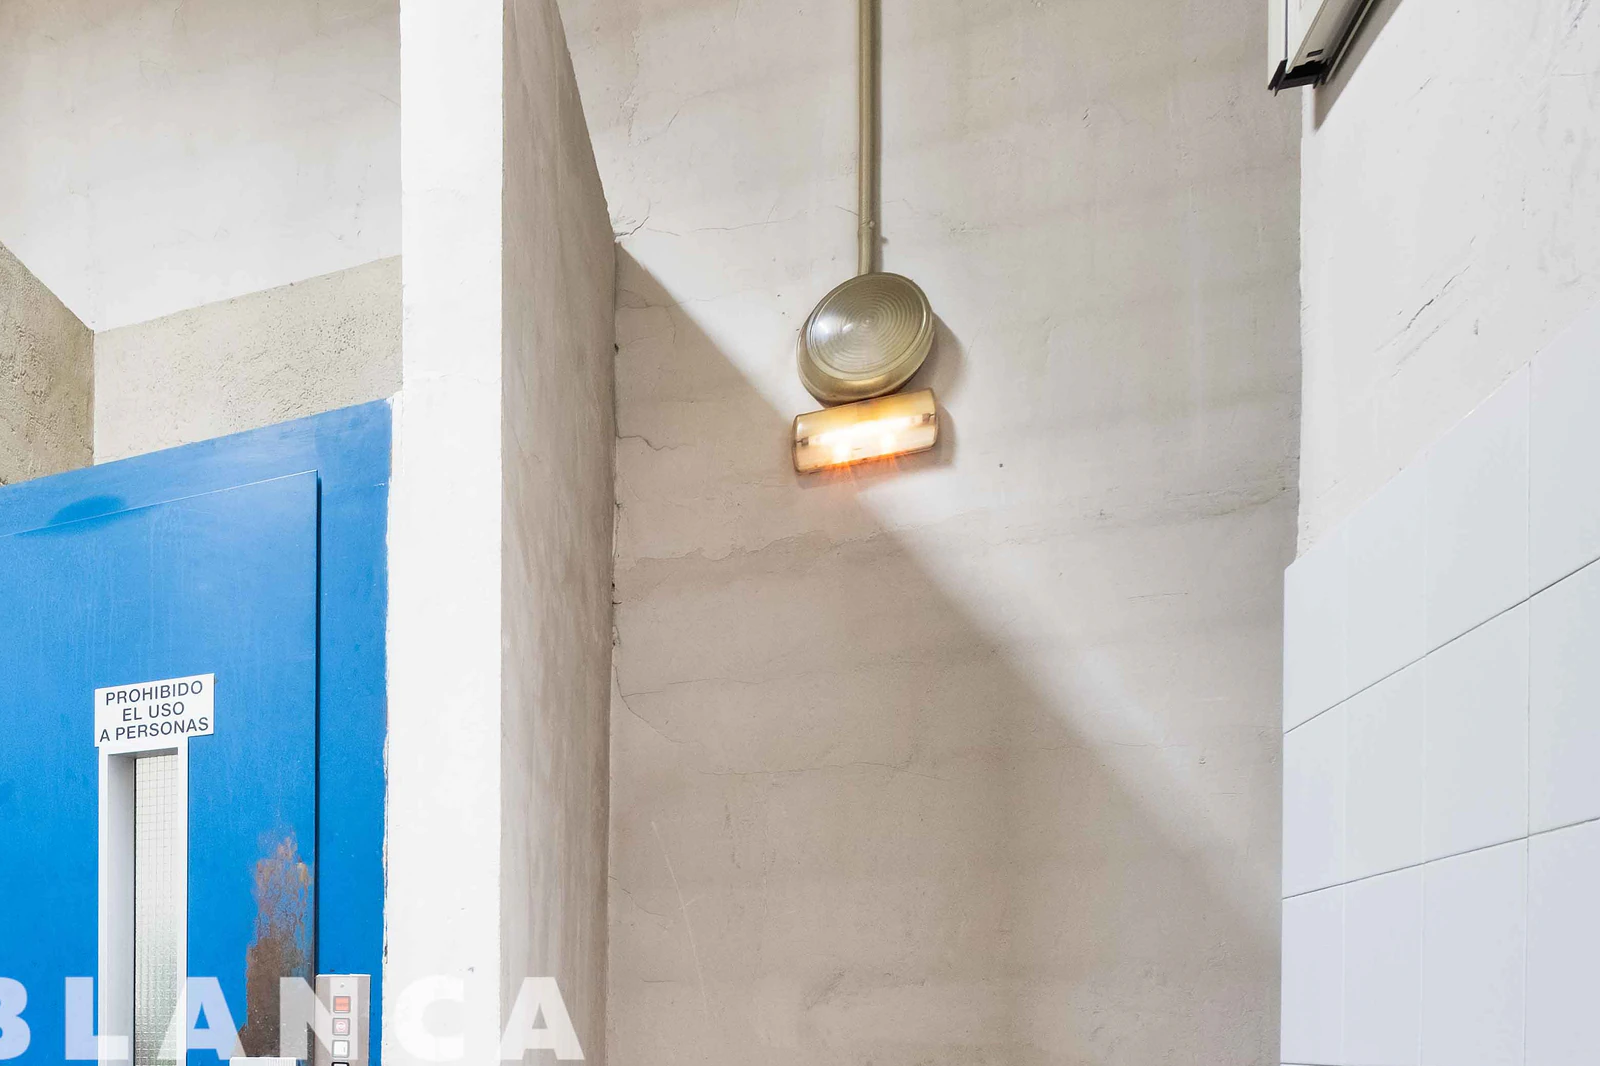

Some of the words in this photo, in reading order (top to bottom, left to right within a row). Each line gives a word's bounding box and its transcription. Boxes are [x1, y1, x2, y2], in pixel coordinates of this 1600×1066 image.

[106, 680, 203, 705] PROHIBIDO
[123, 707, 142, 722] EL
[149, 701, 185, 719] USO
[100, 729, 110, 742] A
[116, 717, 209, 740] PERSONAS
